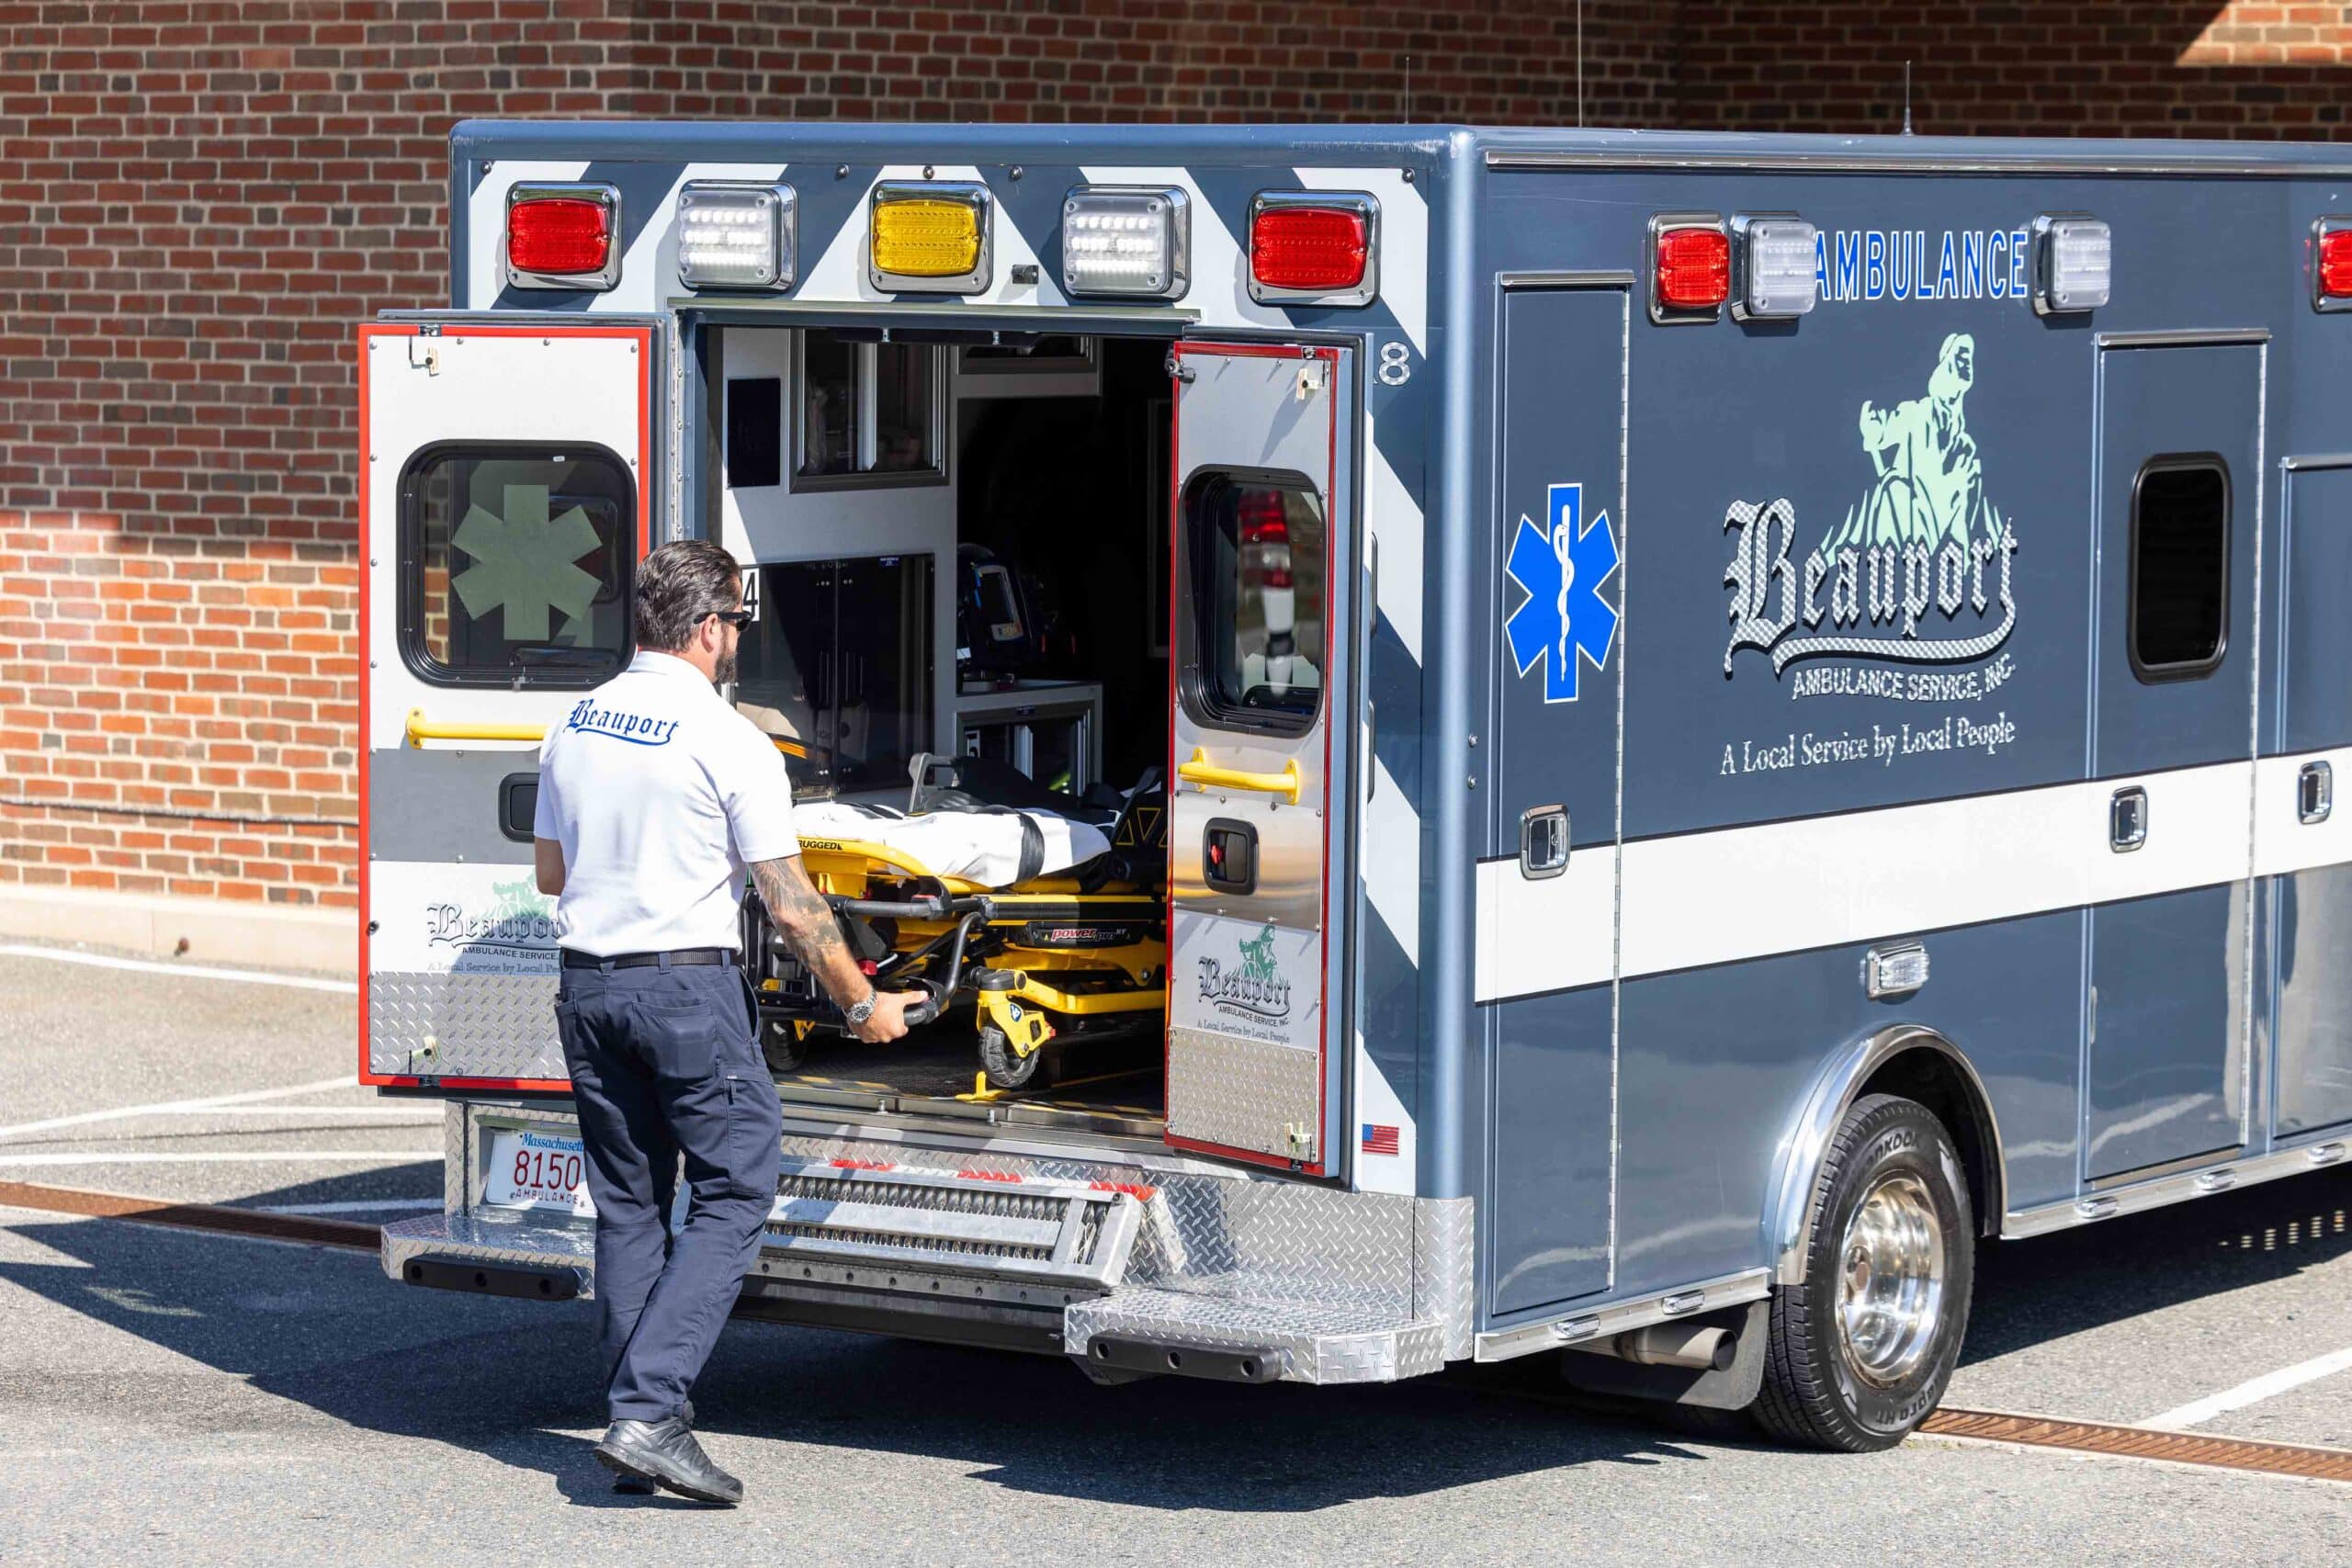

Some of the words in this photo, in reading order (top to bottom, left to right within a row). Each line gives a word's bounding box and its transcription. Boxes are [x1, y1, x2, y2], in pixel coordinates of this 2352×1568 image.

[1815, 230, 2029, 304] AMBULANCE
[1724, 498, 2018, 682] Beauport
[1792, 667, 1904, 701] AMBULANCE
[1906, 671, 1982, 701] SERVICE,
[1984, 652, 2017, 692] INC.
[563, 698, 680, 746] Beauport
[1720, 743, 1736, 775] A
[1742, 734, 1794, 773] Local
[1801, 732, 1869, 765] Service
[1872, 725, 1897, 767] by
[1901, 716, 1951, 755] Local
[1956, 711, 2017, 755] People
[426, 903, 560, 950] Beaupor
[462, 946, 518, 958] AMBULANCE
[466, 962, 501, 972] Service
[516, 964, 543, 973] Local
[1198, 956, 1291, 1017] Beauport
[1218, 1006, 1253, 1021] AMBULANCE
[522, 1133, 584, 1152] Massachusett
[514, 1150, 581, 1191] 8150
[515, 1189, 580, 1205] AMBULANCE
